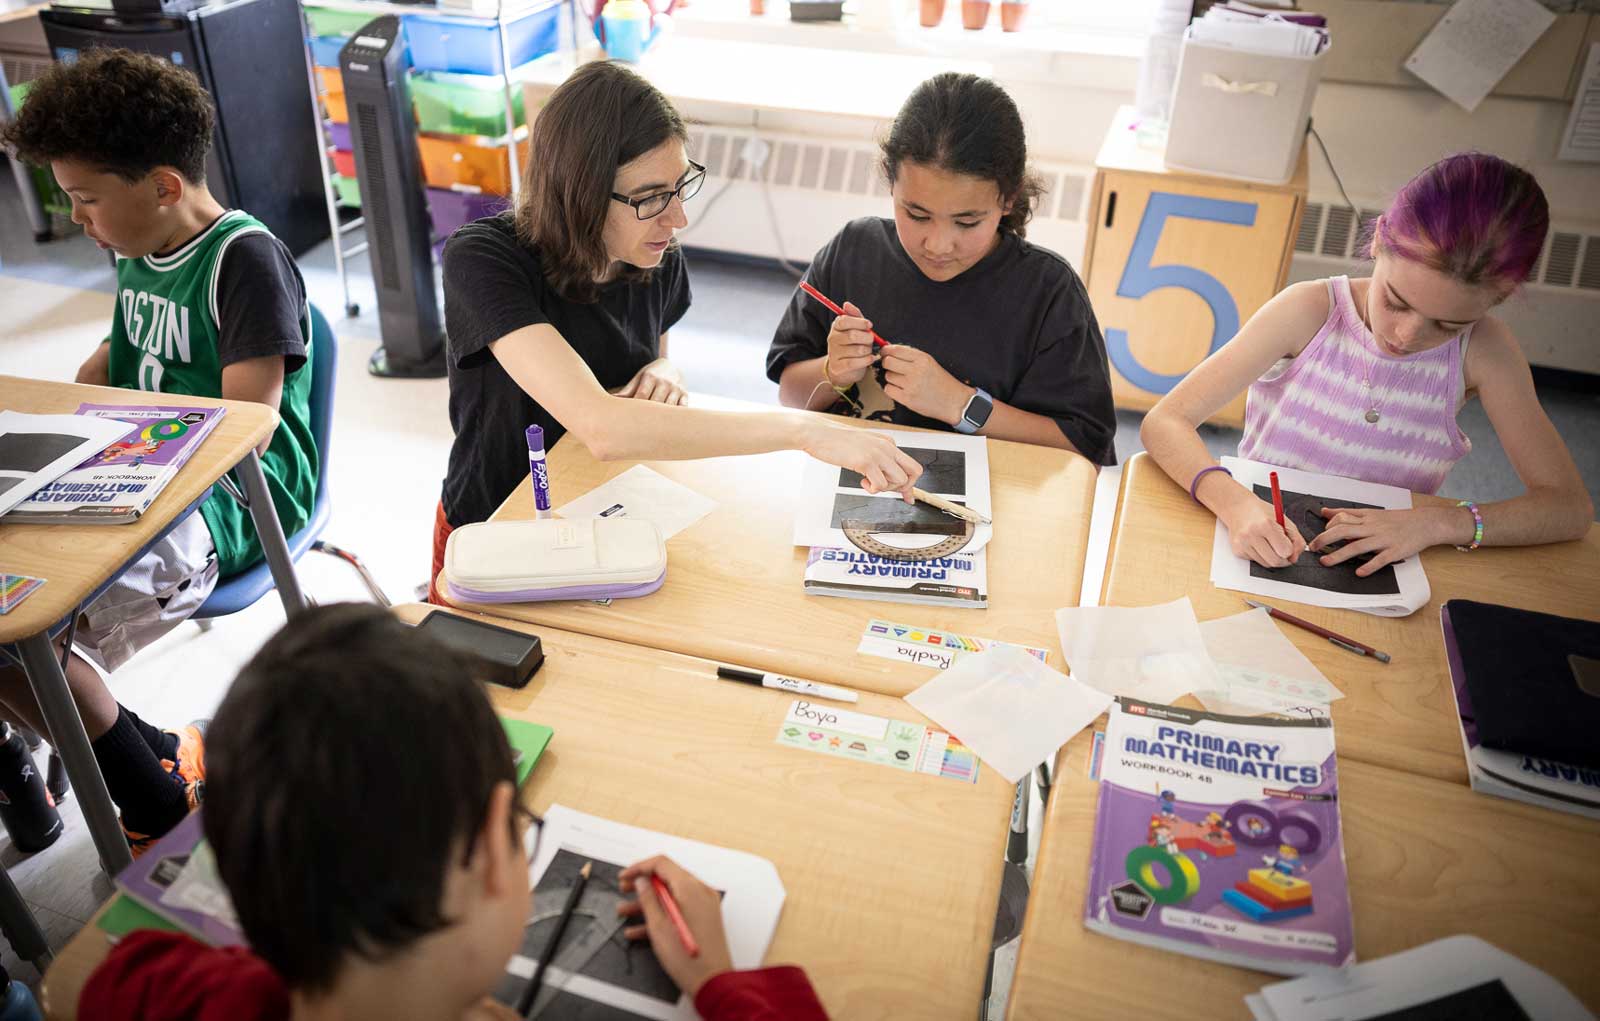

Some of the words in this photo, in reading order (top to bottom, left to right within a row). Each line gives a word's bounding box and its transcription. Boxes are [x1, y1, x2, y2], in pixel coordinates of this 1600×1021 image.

[1104, 191, 1258, 394] 5
[119, 289, 191, 363] OSTON
[534, 463, 548, 489] EXPO
[823, 550, 971, 571] MATHEMATICS
[848, 563, 946, 580] PRIMARY
[897, 646, 951, 670] Radha
[794, 701, 837, 726] Boya
[1158, 726, 1280, 761] PRIMARY
[1121, 759, 1193, 780] WORKBOOK
[1198, 774, 1213, 784] 4B
[1125, 738, 1318, 785] MATHEMATICS
